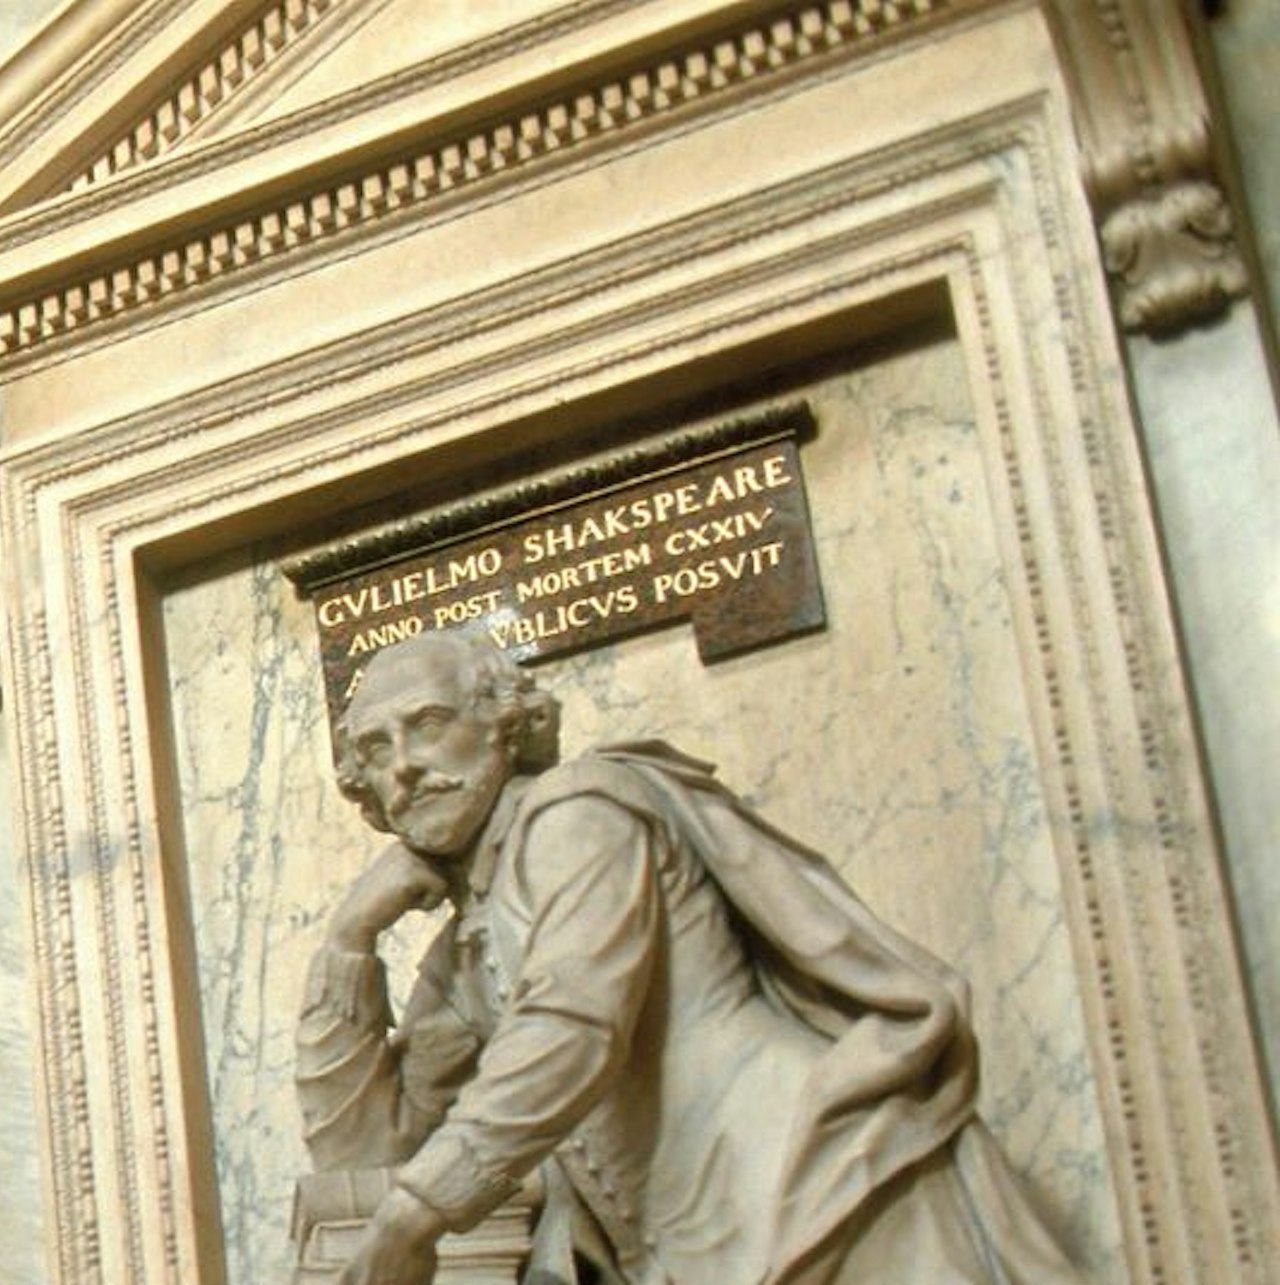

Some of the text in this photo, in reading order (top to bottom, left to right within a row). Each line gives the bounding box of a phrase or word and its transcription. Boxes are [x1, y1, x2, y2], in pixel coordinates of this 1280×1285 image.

[318, 456, 792, 628] GVLIELMO SHAKSPEARE
[347, 508, 774, 658] ANNO POST MORTEM CXXIV
[490, 541, 785, 650] VBLICVS POSVIT
